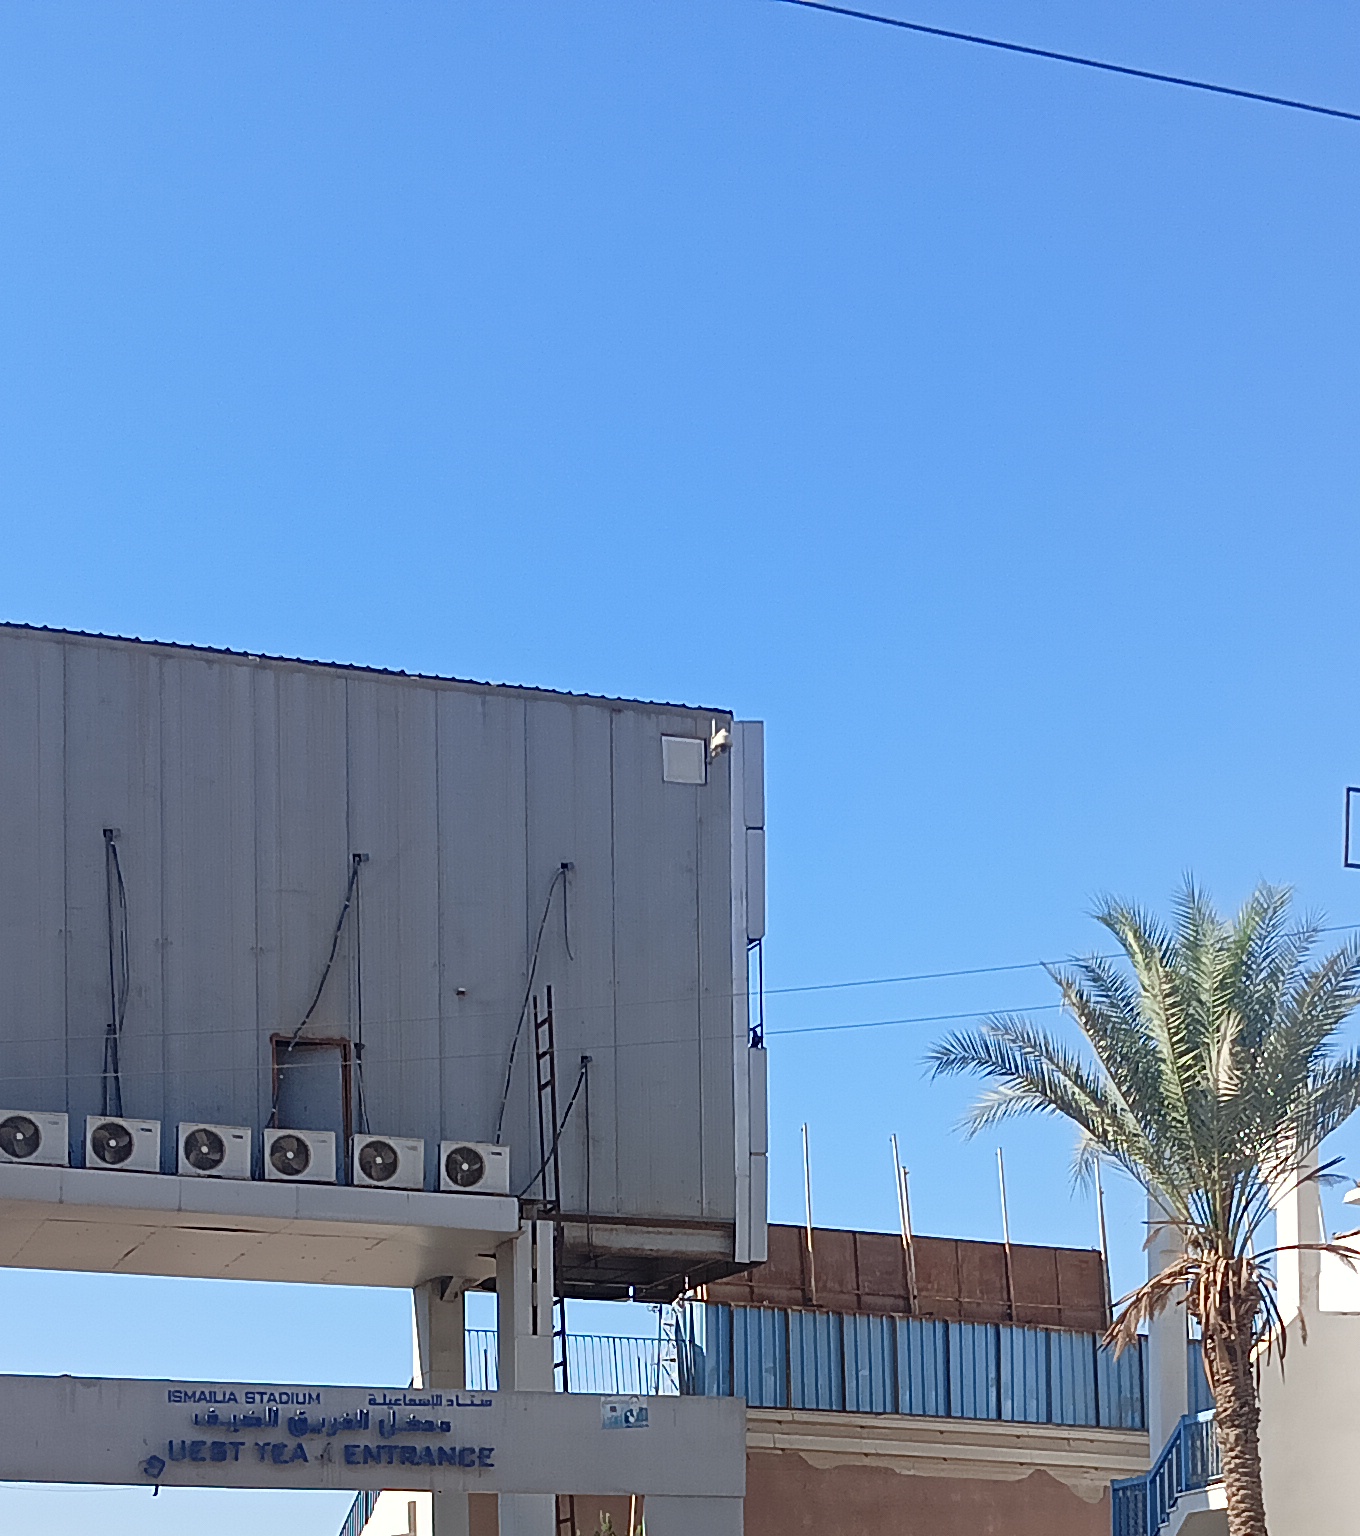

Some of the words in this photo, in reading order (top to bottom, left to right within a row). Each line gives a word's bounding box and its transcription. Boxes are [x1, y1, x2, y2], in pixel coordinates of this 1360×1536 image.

[168, 1390, 238, 1404] ISMAILIA
[245, 1391, 321, 1405] STADIUM
[446, 1394, 493, 1408] ستاد
[378, 1409, 452, 1439] مدخل
[344, 1444, 496, 1468] ENTRANCE
